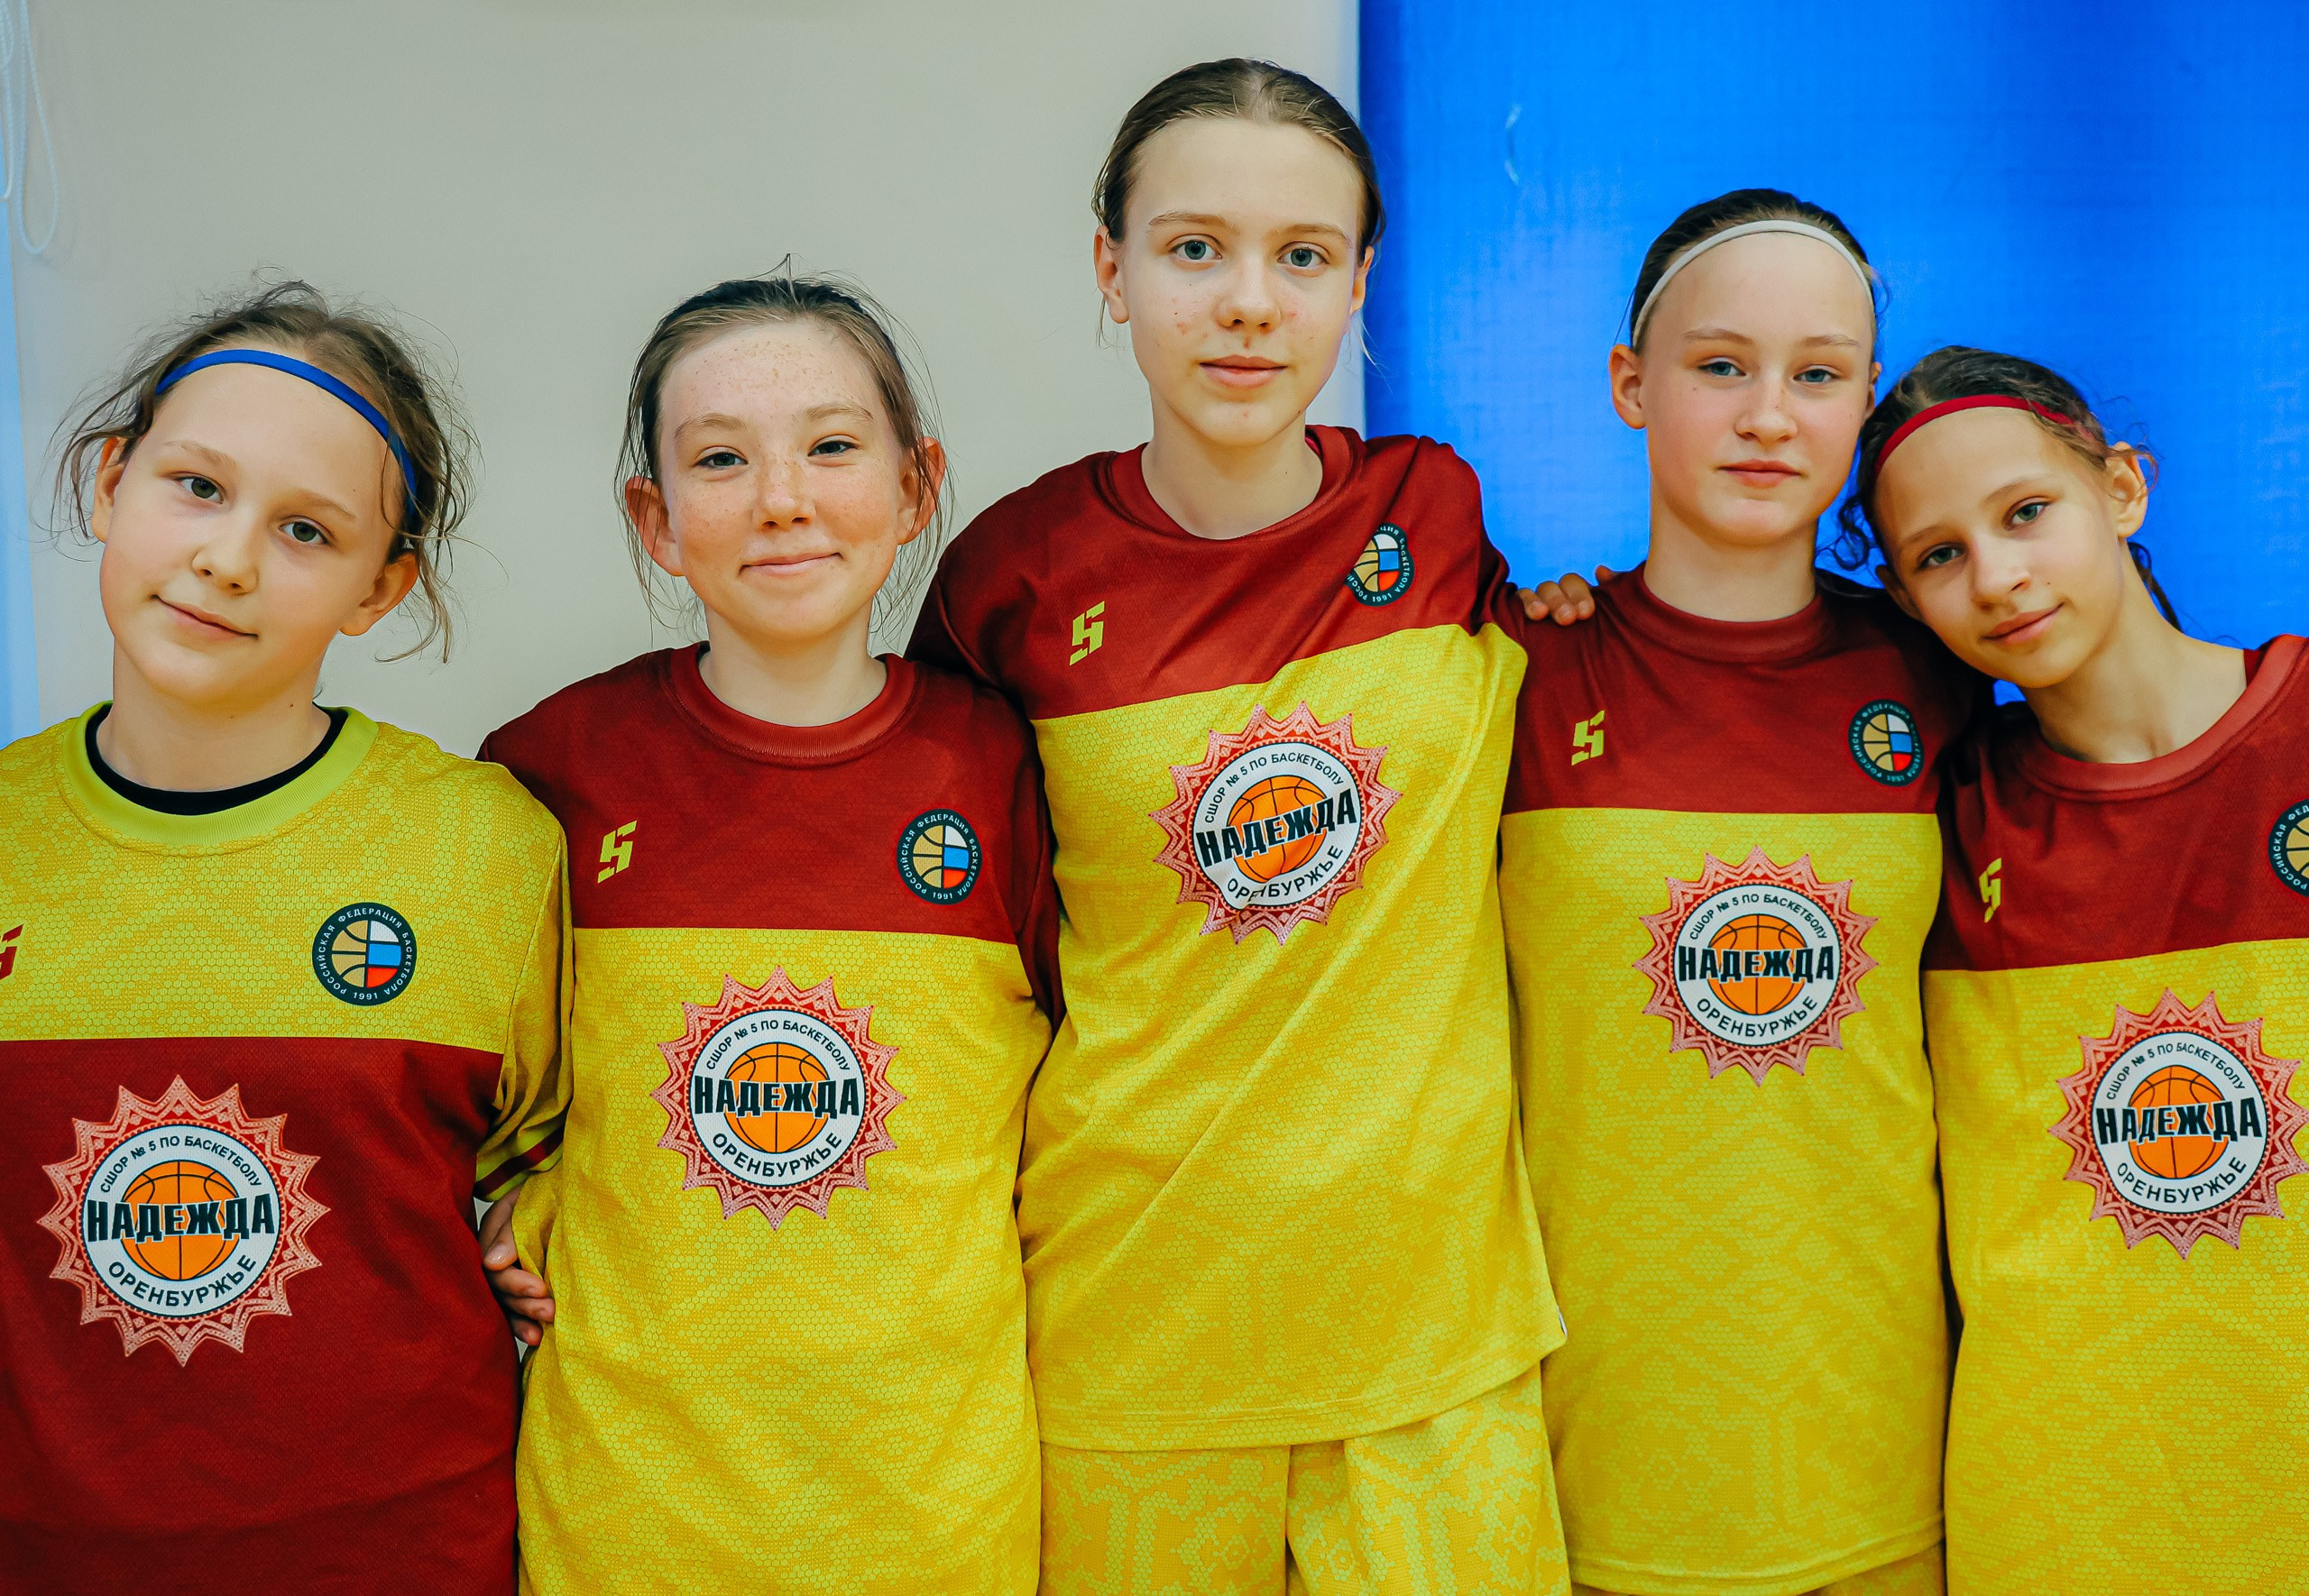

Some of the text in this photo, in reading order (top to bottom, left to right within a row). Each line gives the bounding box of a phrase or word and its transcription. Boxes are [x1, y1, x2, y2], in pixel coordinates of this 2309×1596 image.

[1205, 752, 1344, 824] СШОР № 5 ПО БАСКЕТБОЛУ
[1195, 788, 1357, 868] НАДЕЖДА
[900, 813, 979, 896] РОССИЙСКАЯ ФЕДЕРАЦИЯ БАСКЕТБОЛА
[933, 892, 952, 900] 1991
[1690, 894, 1827, 940] СШОР № 5 ПО БАСКЕТБОЛУ
[317, 907, 412, 995] РОССИЙСКАЯ ФЕДЕРАЦИЯ БАСКЕТБОЛА
[1679, 945, 1835, 984] НАДЕЖДА
[354, 992, 378, 1000] 1991
[1697, 995, 1818, 1038] ОРЕНБУРЖЬЕ
[706, 1019, 851, 1072] СШОР № 5 ПО БАСКЕТБОЛУ
[2106, 1042, 2245, 1100] СШОР № 5 ПО БАСКЕТБОЛУ
[695, 1074, 860, 1120] НАДЕЖДА
[2095, 1096, 2263, 1145] НАДЕЖДА
[100, 1134, 263, 1194] СШОР № 5 ПО БАСКЕТБОЛУ
[713, 1132, 843, 1178] ОРЕНБУРЖЬЕ
[2117, 1156, 2248, 1204] ОРЕНБУРЖЬЕ
[87, 1192, 275, 1243] НАДЕЖДА
[108, 1253, 257, 1307] ОРЕНБУРЖЬЕ
